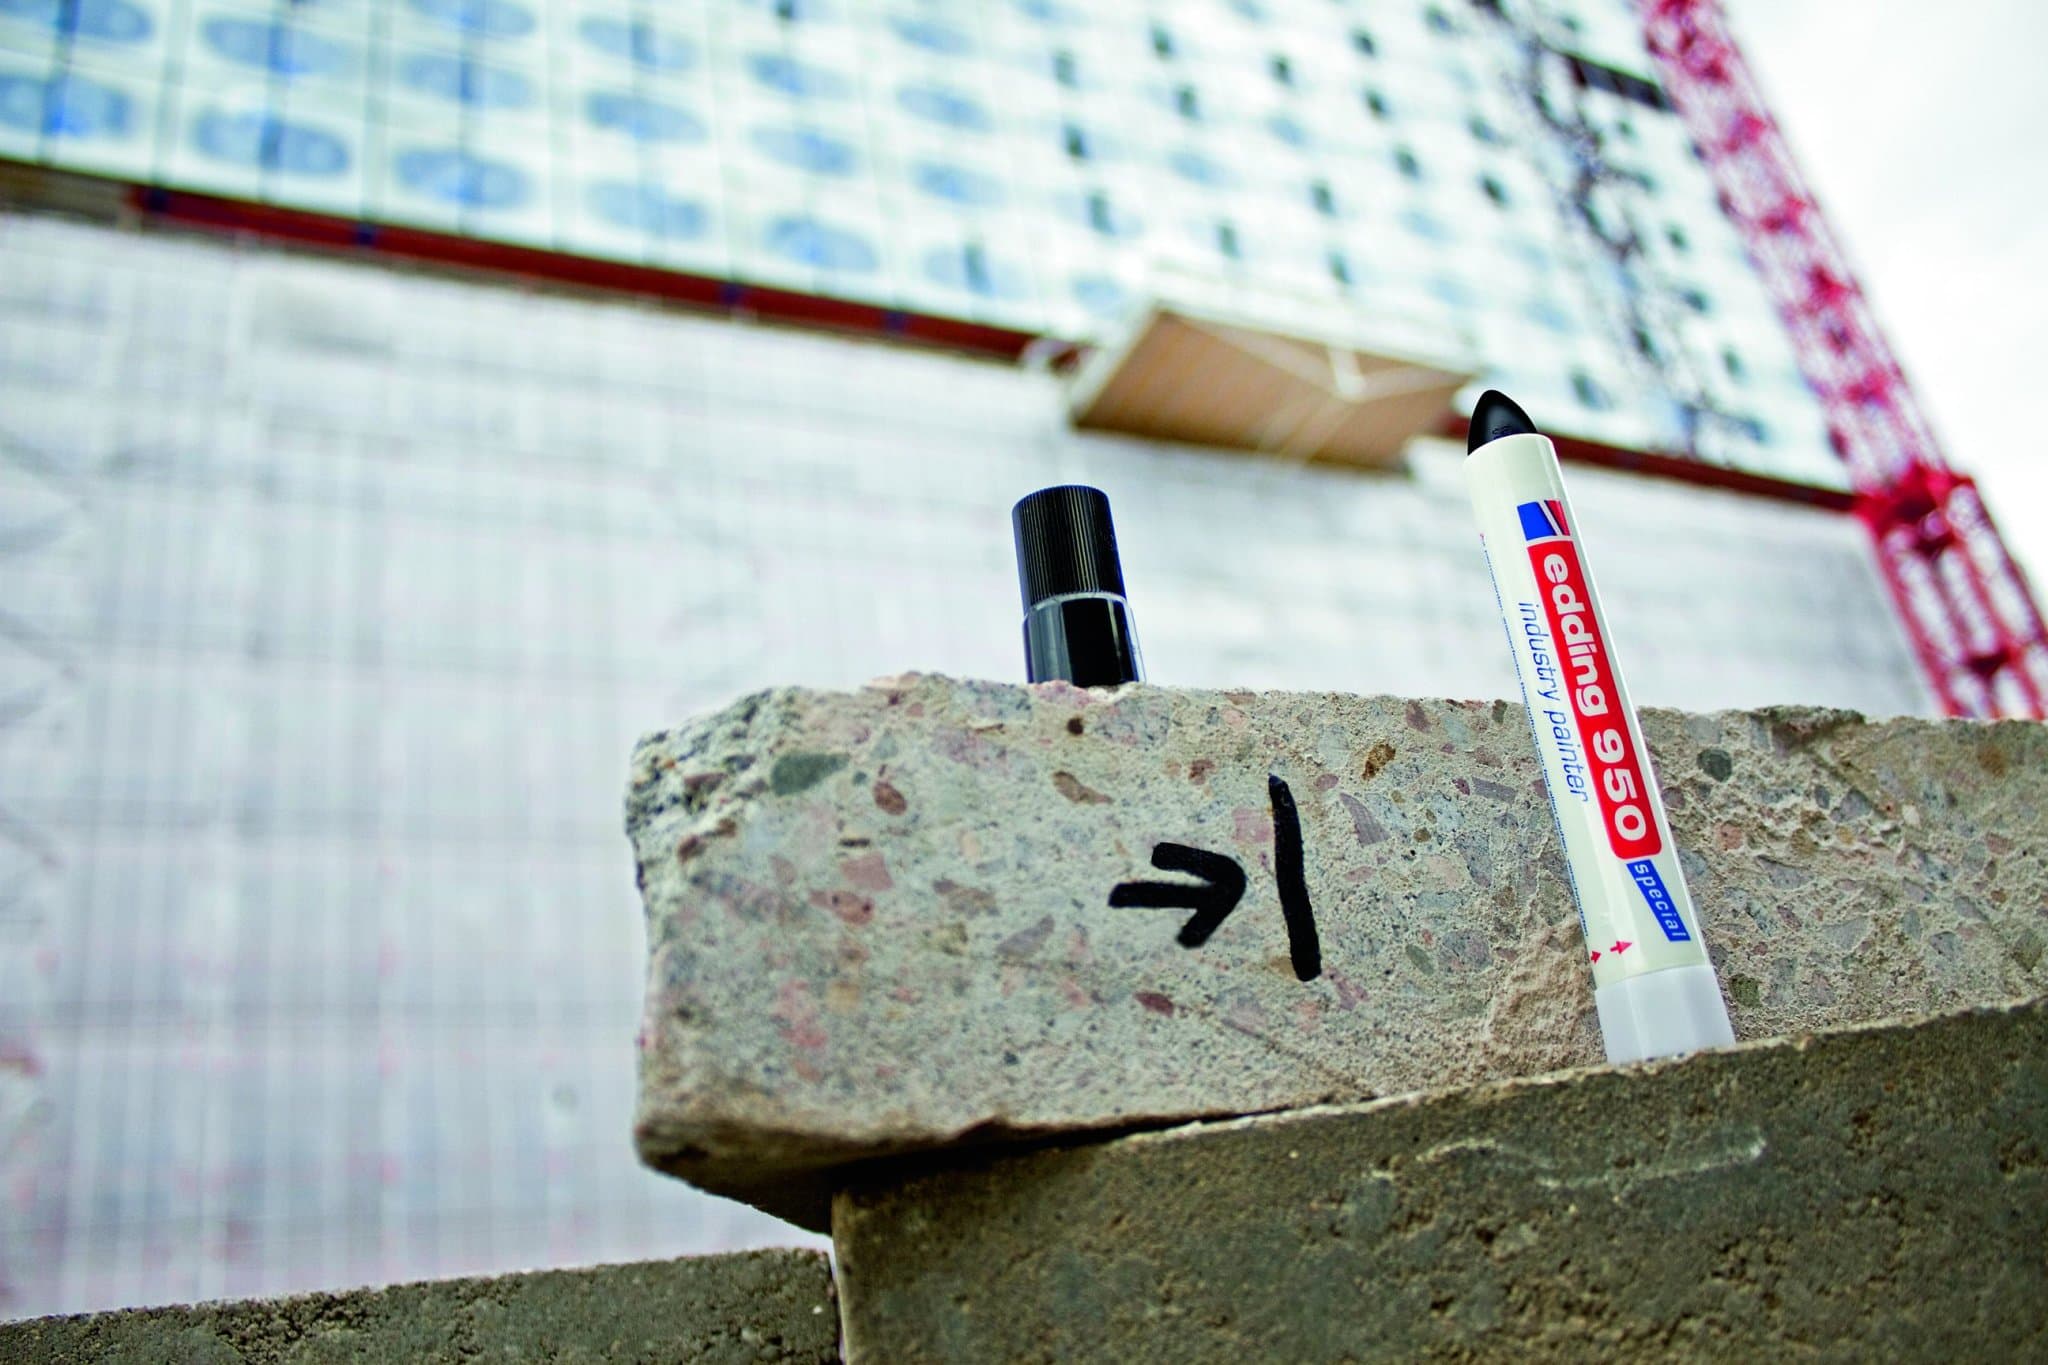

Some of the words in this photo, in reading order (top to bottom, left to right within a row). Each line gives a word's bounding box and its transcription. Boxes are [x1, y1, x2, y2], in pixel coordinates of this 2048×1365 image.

[1518, 602, 1560, 702] industry
[1542, 710, 1588, 802] painter
[1543, 554, 1608, 716] edding
[1593, 729, 1647, 840] 950
[1635, 864, 1686, 937] special
